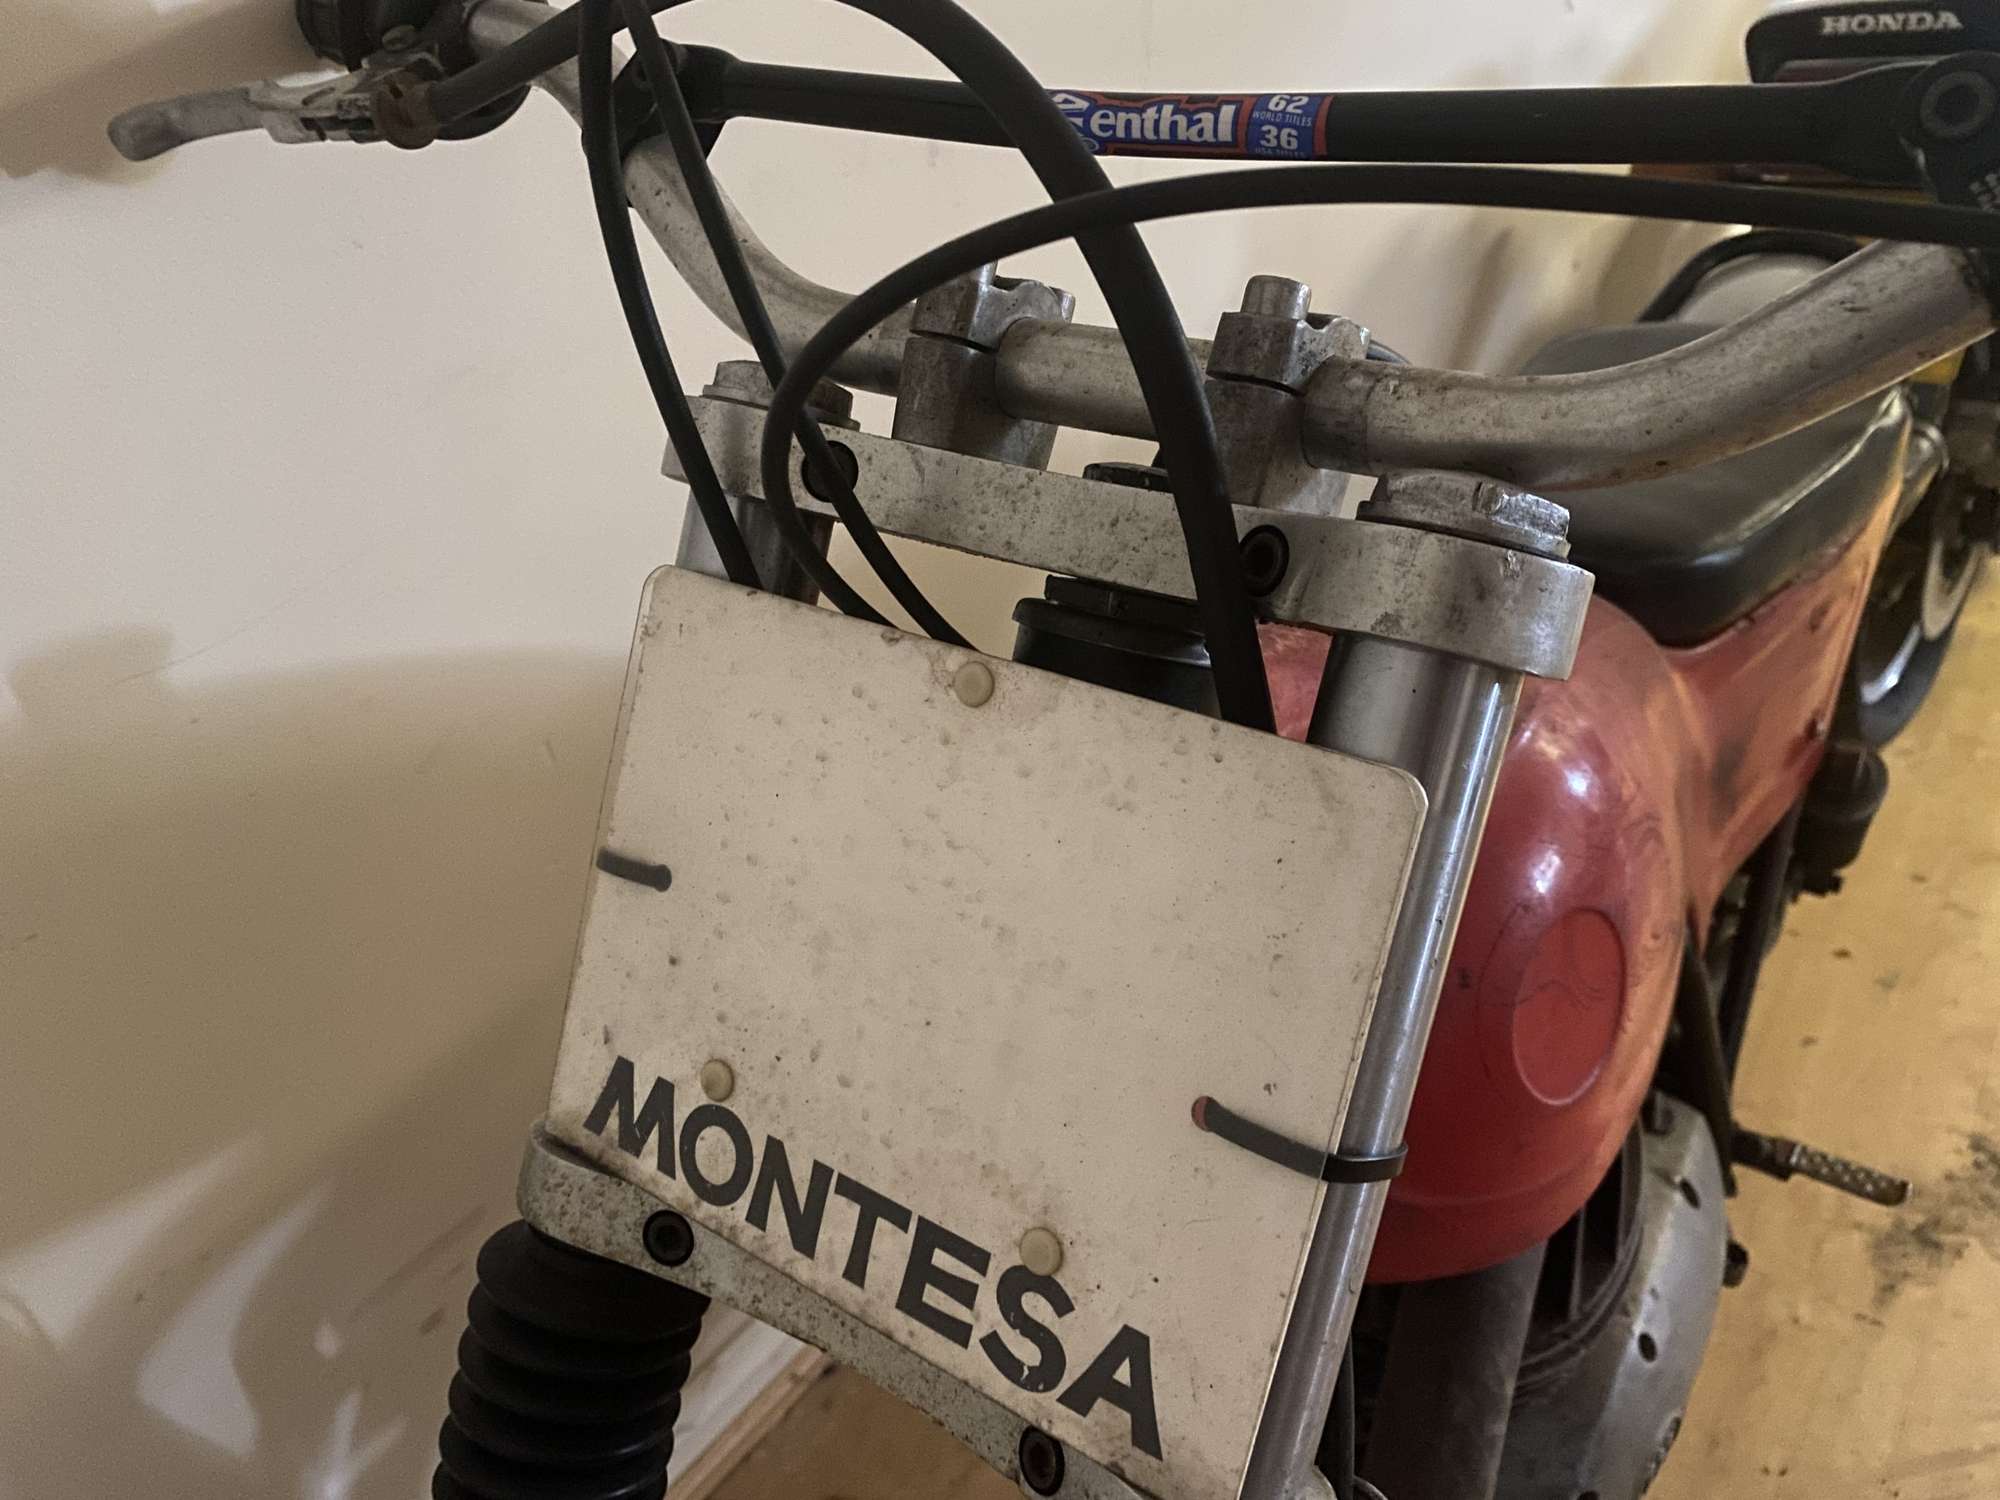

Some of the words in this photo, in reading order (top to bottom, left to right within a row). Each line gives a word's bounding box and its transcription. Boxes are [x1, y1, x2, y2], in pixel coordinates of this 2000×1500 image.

[1820, 11, 1963, 34] HONDA
[1268, 94, 1309, 114] 62
[1259, 124, 1299, 150] 36
[583, 1055, 1163, 1461] MONTESA
